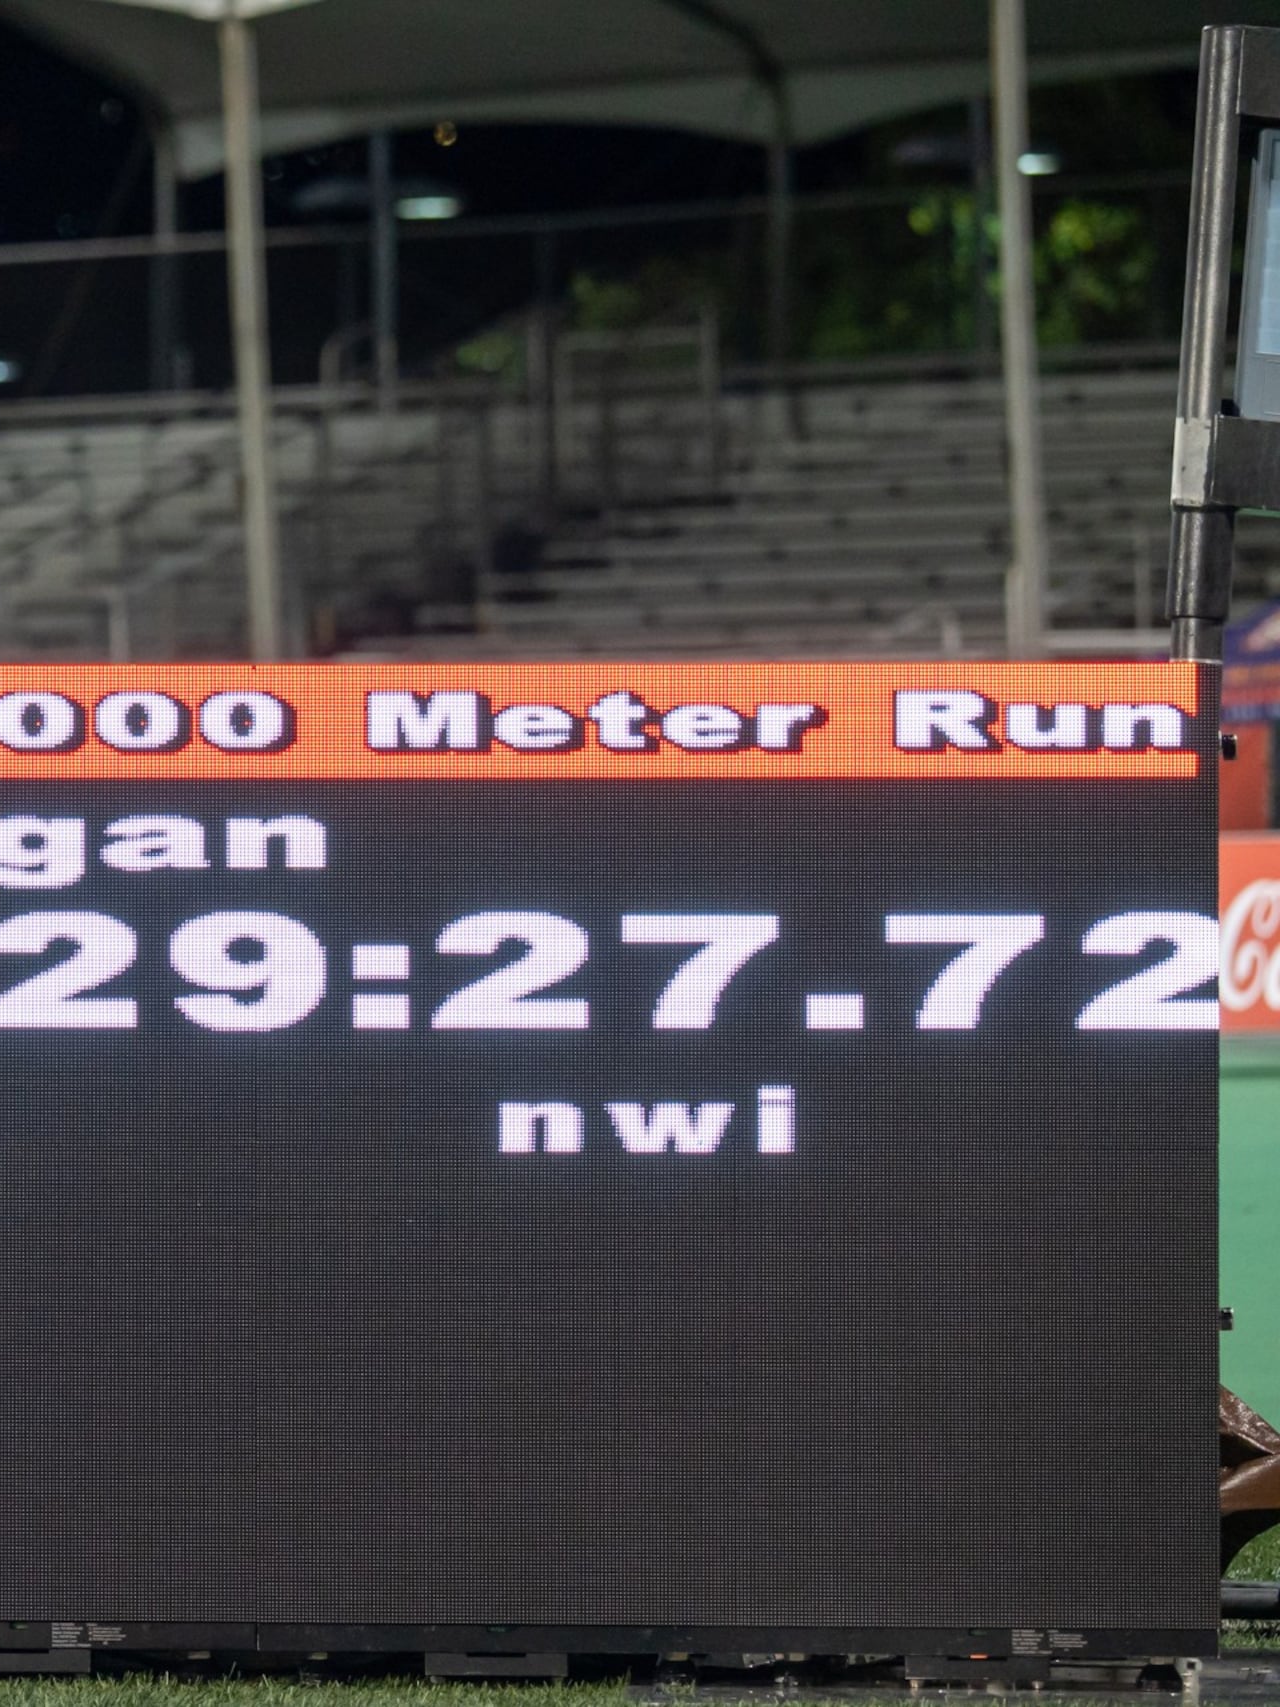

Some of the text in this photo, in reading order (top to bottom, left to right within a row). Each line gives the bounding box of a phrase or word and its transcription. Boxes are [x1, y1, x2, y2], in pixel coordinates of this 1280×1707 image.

[366, 690, 820, 751] Meter
[893, 689, 1184, 749] Run
[498, 1084, 796, 1153] nwi
